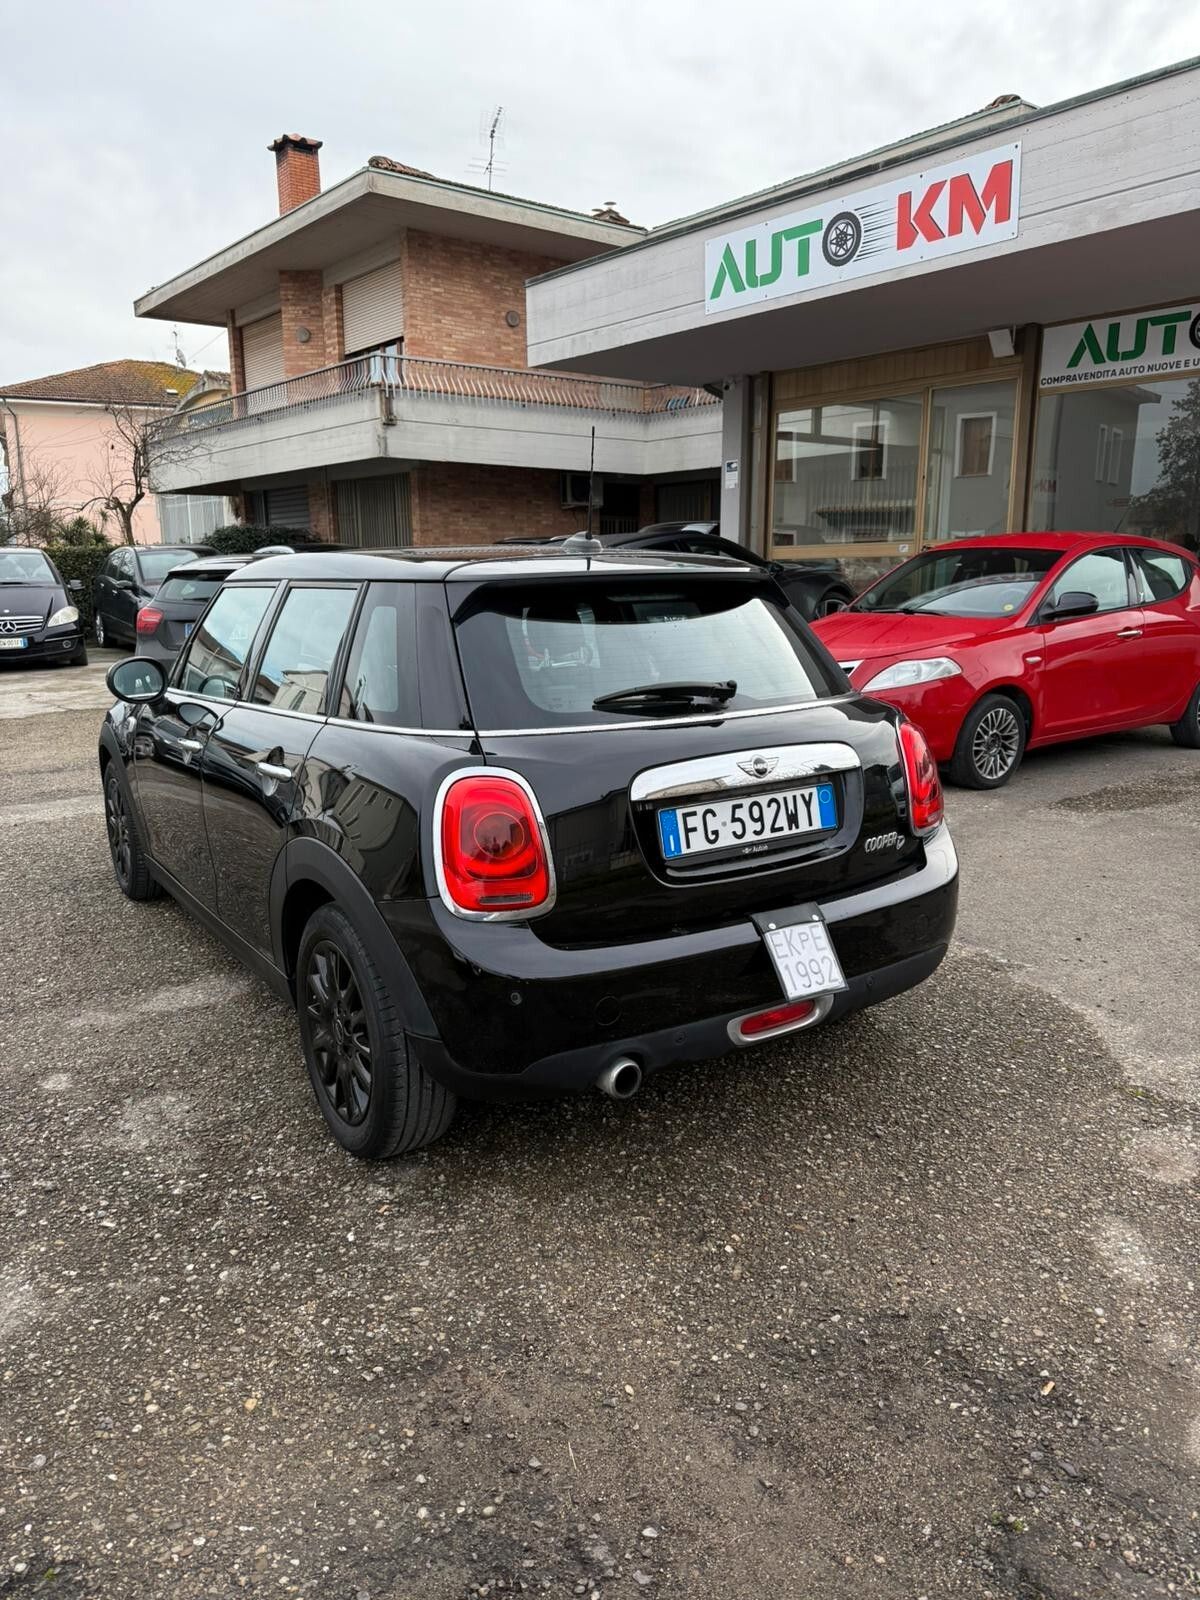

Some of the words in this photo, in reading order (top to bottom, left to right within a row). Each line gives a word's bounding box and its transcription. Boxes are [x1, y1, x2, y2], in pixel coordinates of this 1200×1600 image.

[896, 159, 1014, 251] KM
[1066, 310, 1200, 368] AUT
[1040, 368, 1117, 386] COMPRAVENDITA
[1118, 365, 1145, 376] AUTO
[1147, 360, 1182, 373] NUOVE
[1183, 359, 1190, 368] E
[682, 808, 720, 849] FG
[730, 792, 813, 840] 592WY
[865, 831, 898, 853] COOPER
[784, 955, 839, 992] 1992
